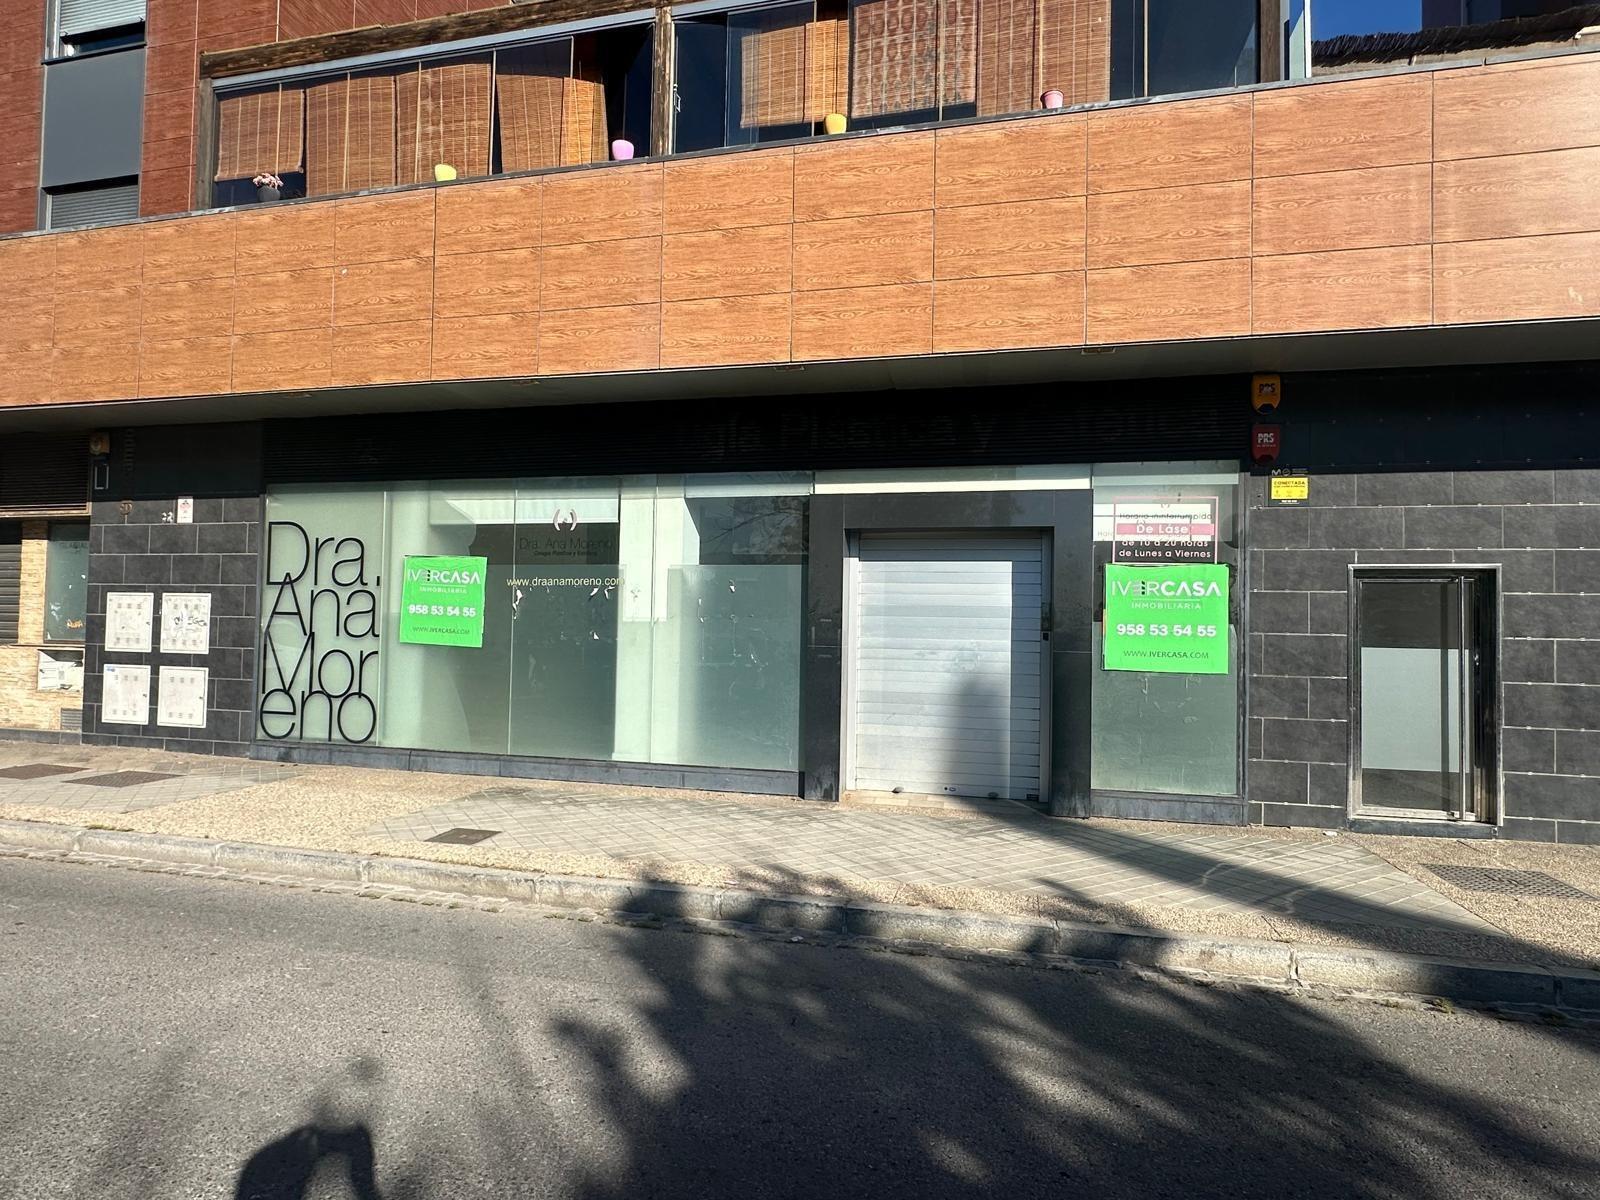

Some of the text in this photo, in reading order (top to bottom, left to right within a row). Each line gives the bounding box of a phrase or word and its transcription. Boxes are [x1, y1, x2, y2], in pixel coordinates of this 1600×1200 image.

[1257, 432, 1274, 443] PRS
[1136, 522, 1190, 534] De Láse
[545, 537, 567, 550] Ana
[266, 521, 381, 587] Dra.
[1119, 549, 1131, 557] de
[1134, 549, 1162, 557] Lunes
[1175, 549, 1211, 558] Viernes
[407, 569, 481, 584] IVERCASA
[506, 576, 625, 587] www.draanamoreno.com
[1111, 580, 1222, 597] IVERCASA
[264, 572, 380, 638] Ana
[408, 603, 476, 618] 958 53 54 55
[1131, 602, 1202, 610] INMOBILIARIA
[1116, 623, 1217, 637] 958 53 54 55
[1123, 650, 1209, 660] WWW.IVERCASA.COM
[259, 688, 377, 744] eno
